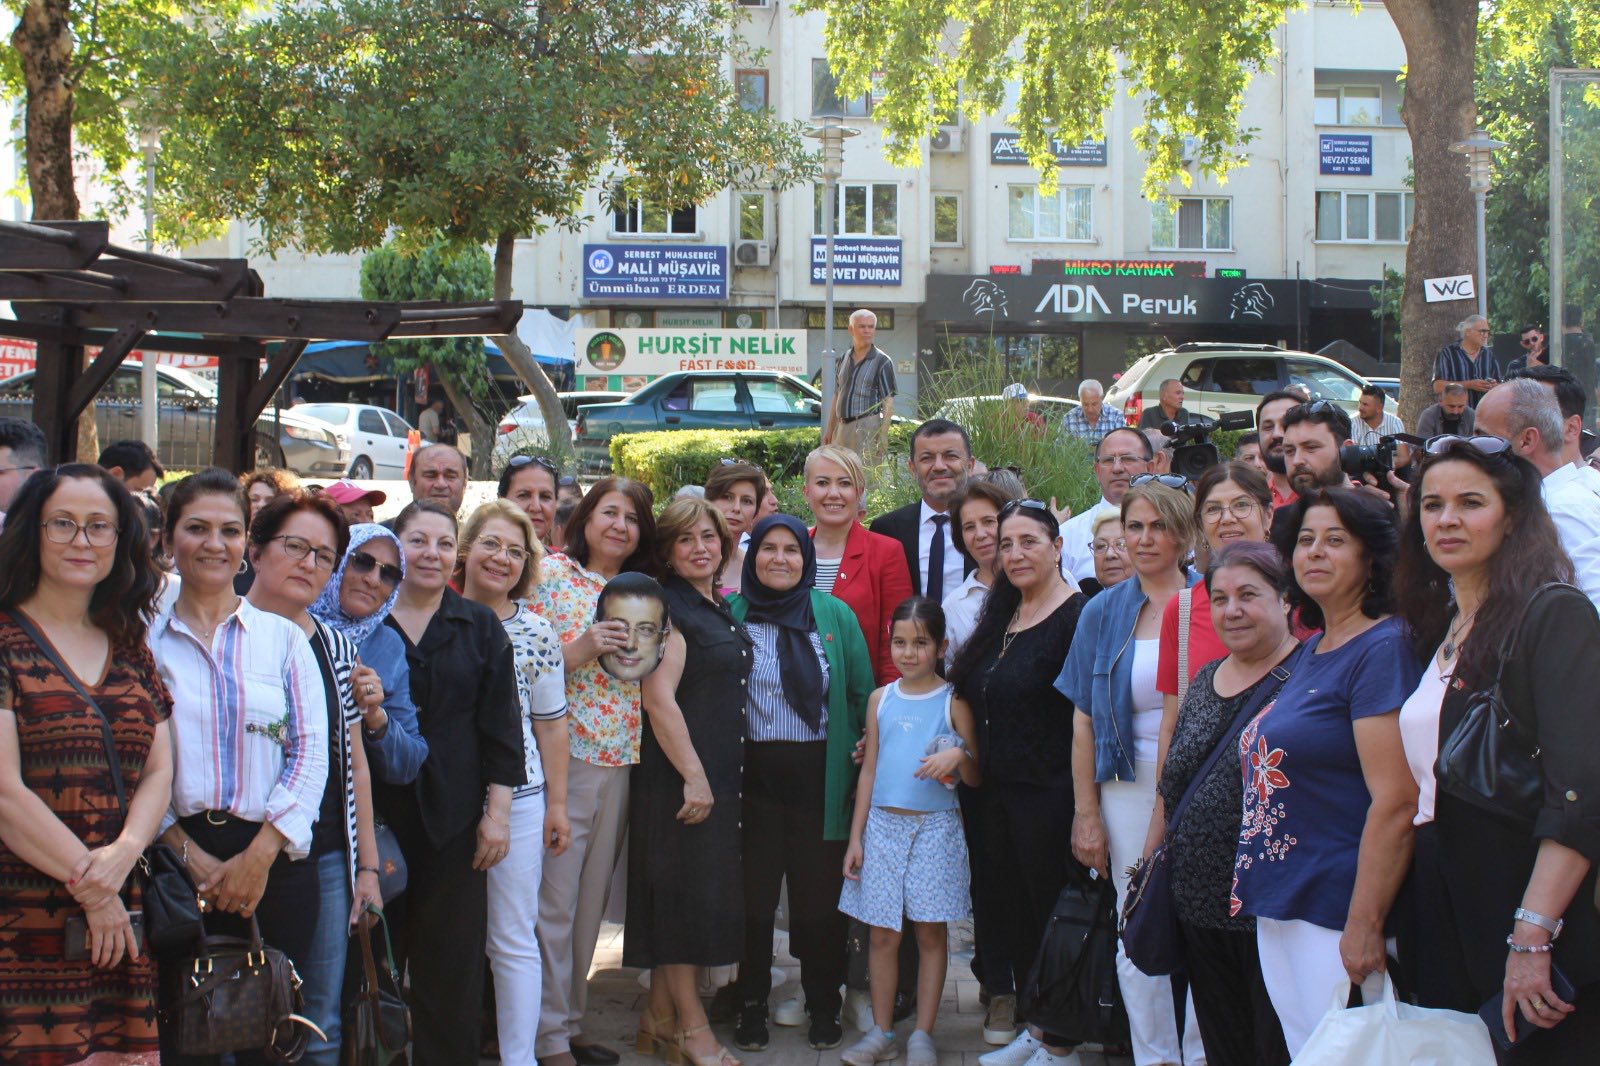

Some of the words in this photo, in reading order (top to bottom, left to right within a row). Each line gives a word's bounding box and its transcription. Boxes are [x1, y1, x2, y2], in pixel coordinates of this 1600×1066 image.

[1322, 156, 1349, 164] NEVZAT
[1349, 155, 1370, 165] SERİN
[624, 250, 660, 259] SERBEST
[665, 250, 717, 260] MUHASEBECİ
[834, 253, 856, 263] MALİ
[858, 253, 899, 265] MÜŞAVİR
[618, 260, 652, 275] MALİ
[658, 260, 720, 278] MÜŞAVİR
[860, 268, 899, 280] DURAN
[1064, 260, 1112, 276] MİKRO
[1115, 262, 1175, 277] KAYNAK
[589, 281, 659, 293] Ümmühan
[668, 284, 720, 294] ERDEM
[1432, 280, 1472, 296] WC
[1034, 284, 1112, 314] ADA
[1122, 293, 1197, 315] Peruk
[638, 332, 722, 358] HURŞİT
[730, 332, 796, 354] NELİK
[680, 360, 712, 370] FAST
[716, 359, 756, 370] FOOD
